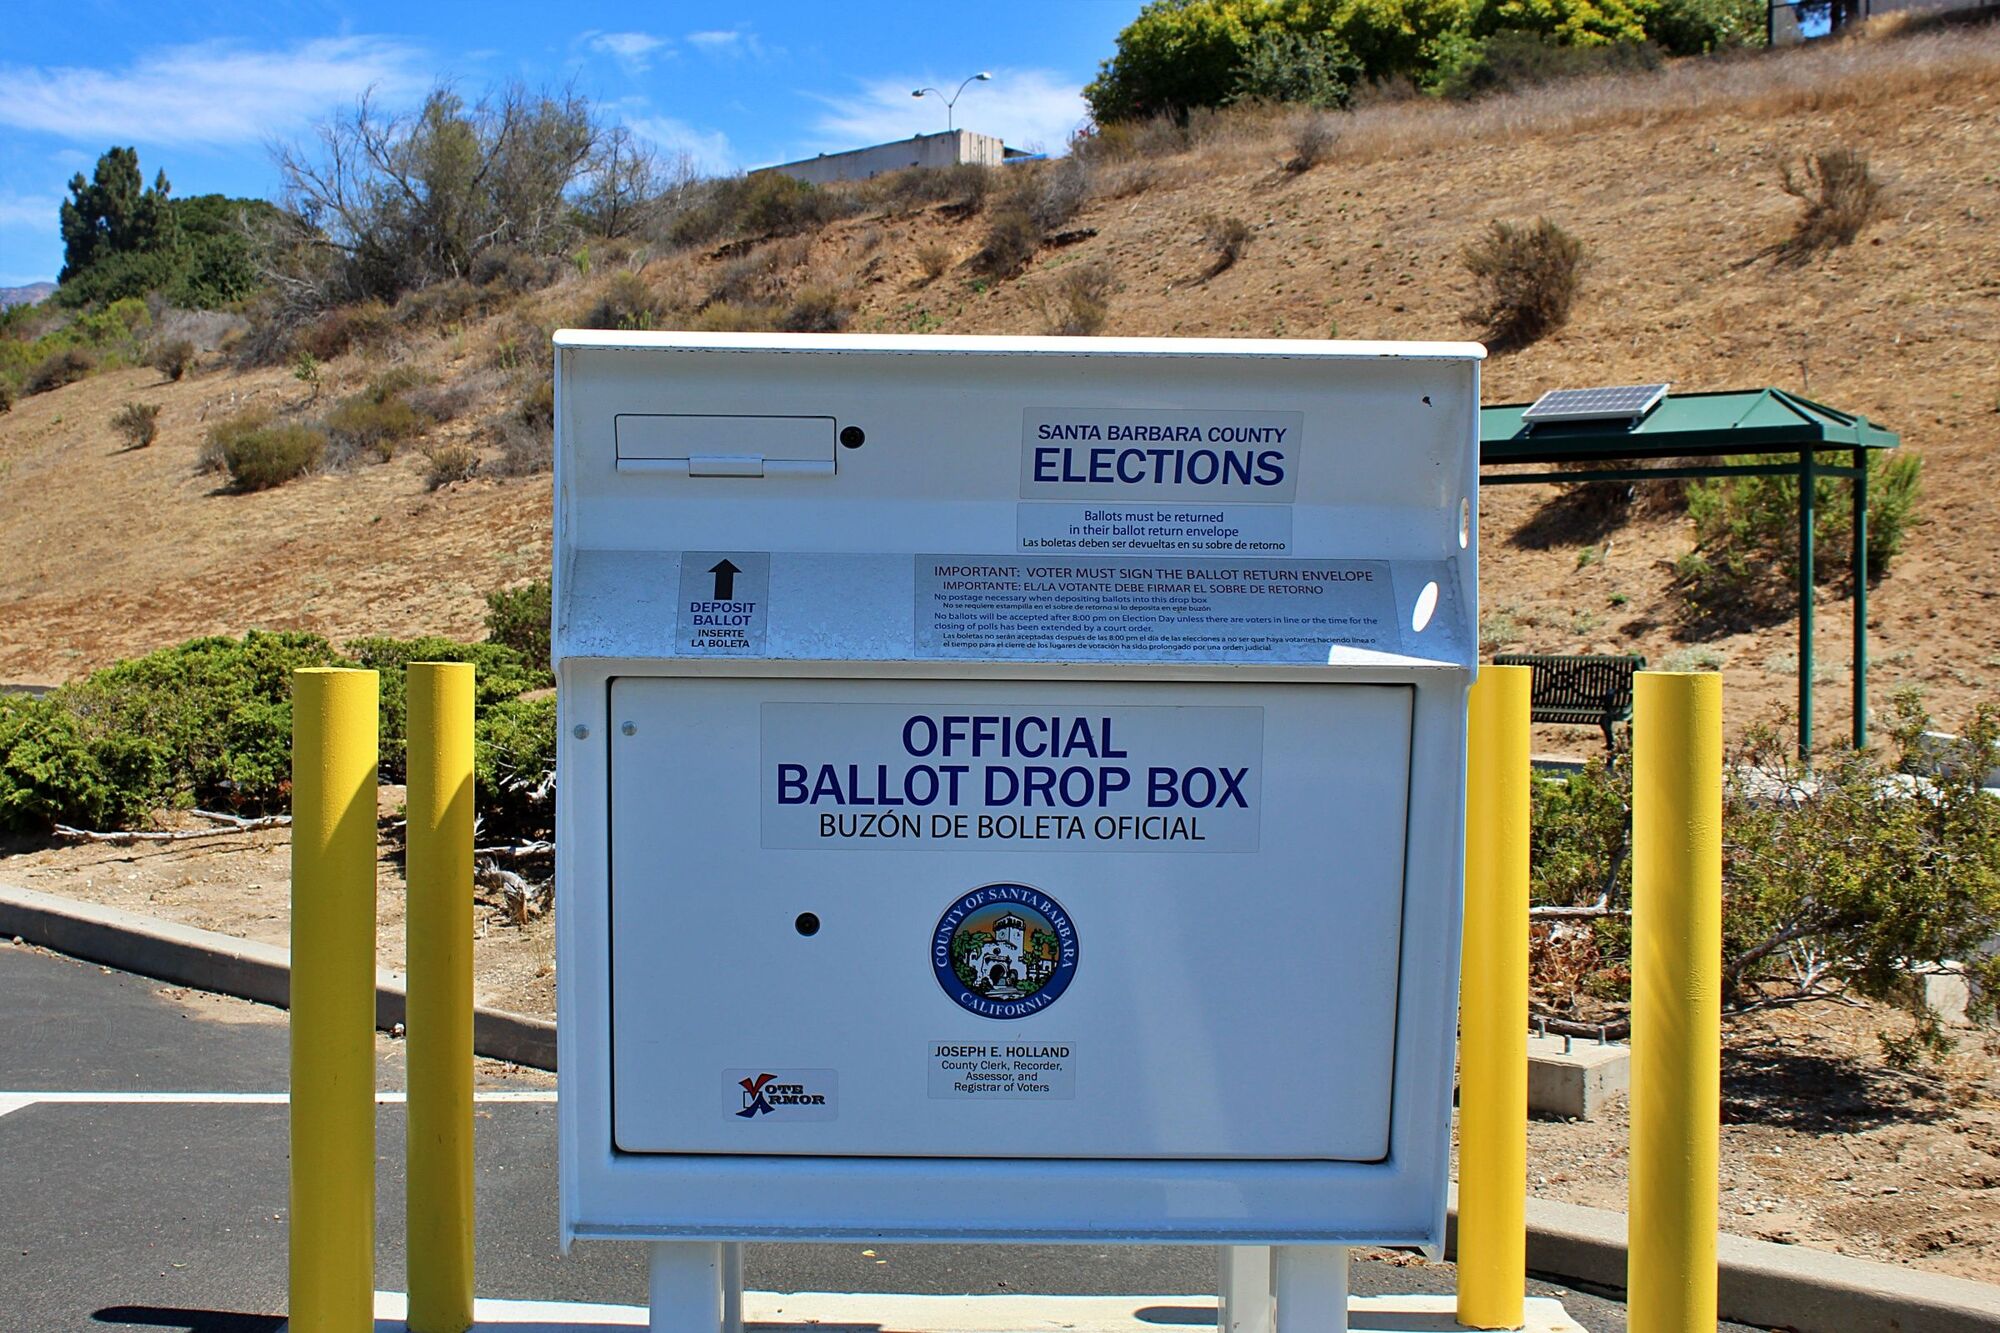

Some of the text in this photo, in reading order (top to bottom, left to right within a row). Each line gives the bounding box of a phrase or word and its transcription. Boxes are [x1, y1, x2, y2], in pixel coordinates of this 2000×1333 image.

[1038, 425, 1287, 443] SANTA BARBARA COUNTY
[1034, 448, 1285, 485] ELECTIONS
[1085, 511, 1224, 522] Ballots must be returned
[1069, 525, 1238, 538] in their ballot return envelope
[1023, 538, 1038, 547] Las
[1041, 538, 1076, 547] boletas
[1079, 539, 1109, 547] deben
[1129, 540, 1175, 548] devueltas
[1206, 541, 1232, 549] sobre
[1235, 540, 1247, 549] de
[934, 567, 1373, 581] IMPORTANT: VOTER MUST SIGN THE BALLOT RETURN ENVELOPE
[944, 582, 1323, 594] IMPORTANTE: EL/LA VOTANTE DEBE FIRMAR EL SOBRE DE RETORNO
[949, 594, 981, 602] postage
[691, 602, 756, 613] DEPOSIT
[693, 615, 751, 626] BALLOT
[978, 623, 998, 631] polls
[1084, 624, 1094, 632] by
[902, 715, 1127, 759] OFFICIAL
[777, 764, 1248, 809] BALLOT DROP BOX
[820, 809, 1205, 841] BUZÓN DE BOLETA OFICIAL
[936, 889, 1074, 967] COUNTY OF SANTA BARBARA
[961, 992, 1052, 1015] CALIFORNIA
[935, 1046, 1069, 1058] JOSEPH E. HOLLAND
[942, 1060, 1062, 1071] County Clerk, Recorder,
[966, 1072, 1037, 1081] Assessor, and
[955, 1082, 1049, 1093] Registrar of Voters
